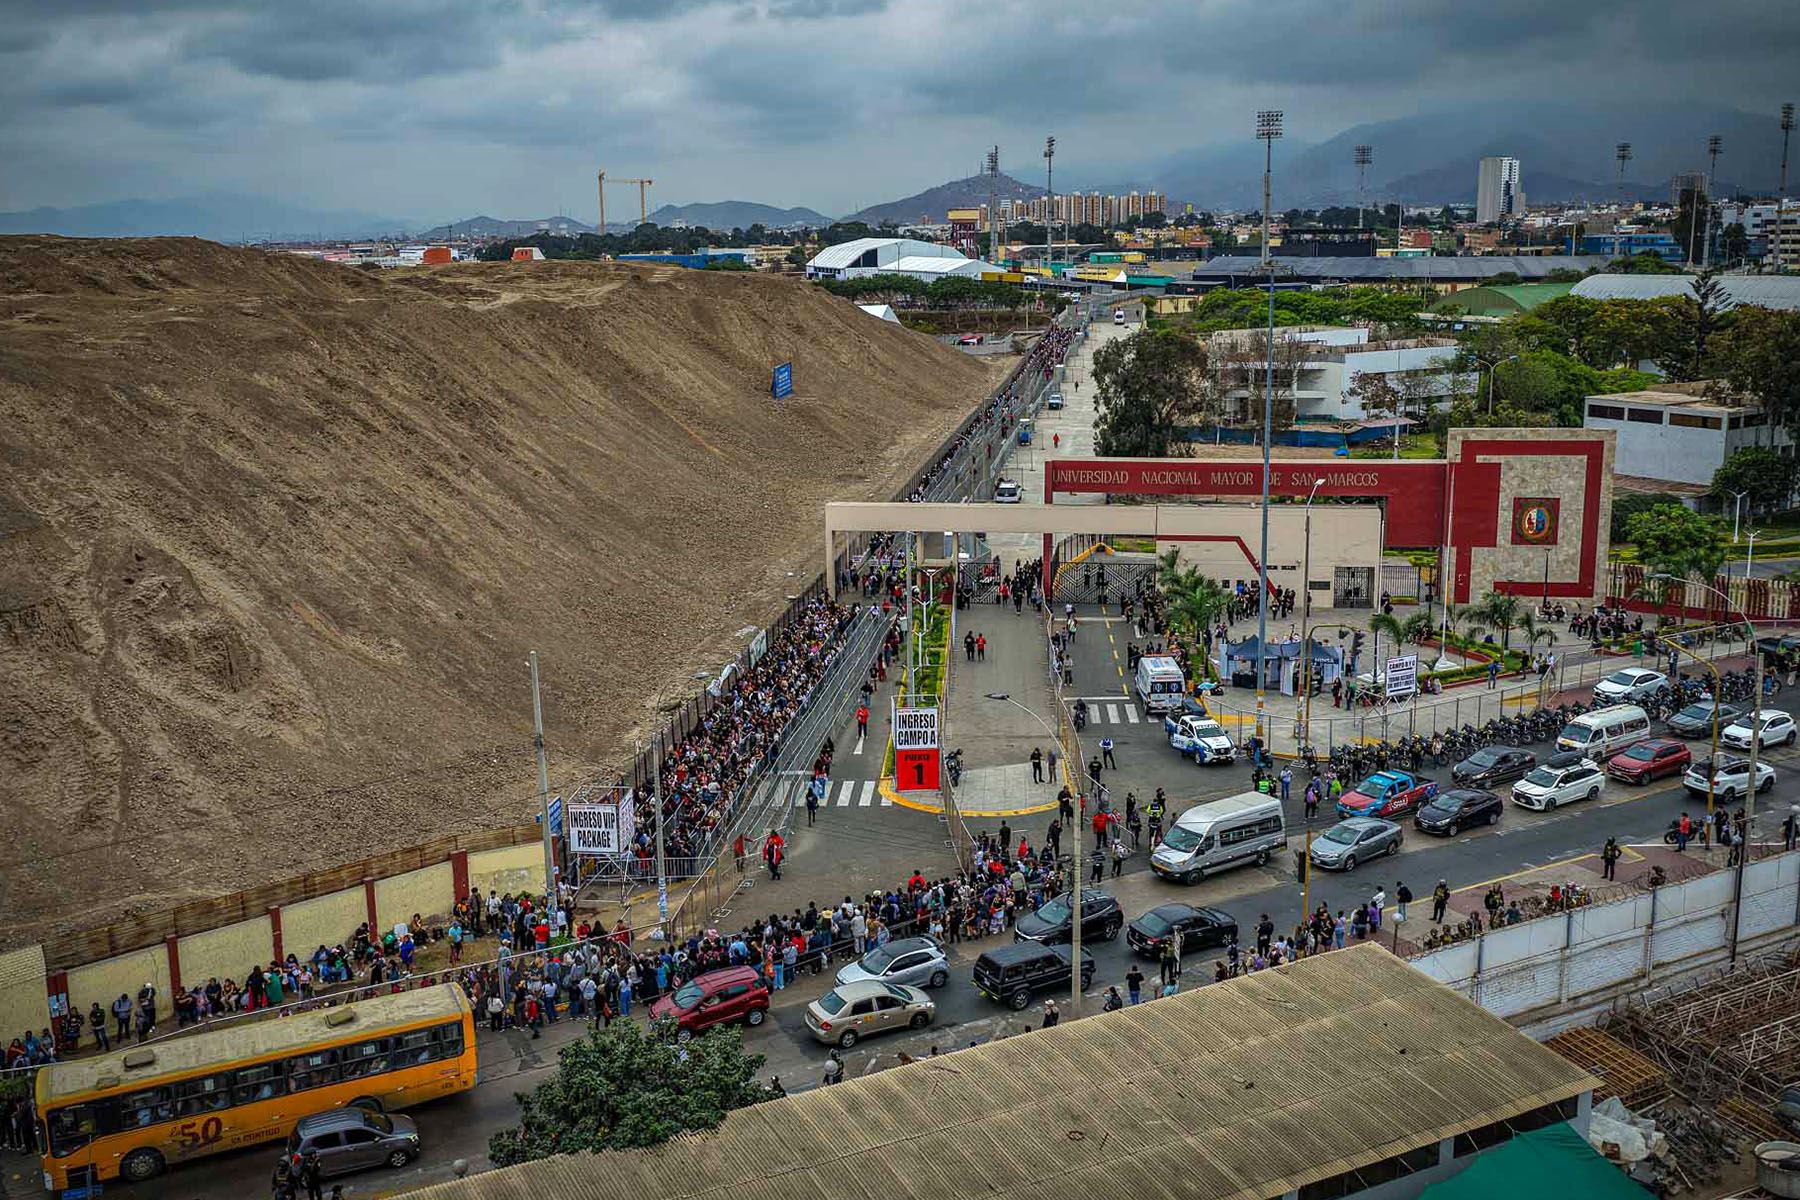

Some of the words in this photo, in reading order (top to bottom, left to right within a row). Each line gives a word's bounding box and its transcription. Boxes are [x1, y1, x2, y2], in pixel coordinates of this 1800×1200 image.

[1052, 469, 1129, 484] UNIVERSIDAD
[1141, 470, 1201, 485] NACIONAL
[1210, 471, 1254, 486] MAYOR
[1268, 472, 1281, 487] DE
[1291, 472, 1317, 487] SAN
[1327, 472, 1379, 487] MARCOS
[898, 713, 935, 729] INGRESO
[897, 730, 928, 746] CAMPO
[930, 730, 936, 745] A
[912, 762, 924, 785] 1
[570, 811, 602, 828] INGRESO
[603, 811, 615, 829] VIP
[577, 830, 611, 848] PACKAGE
[180, 1116, 223, 1148] 50
